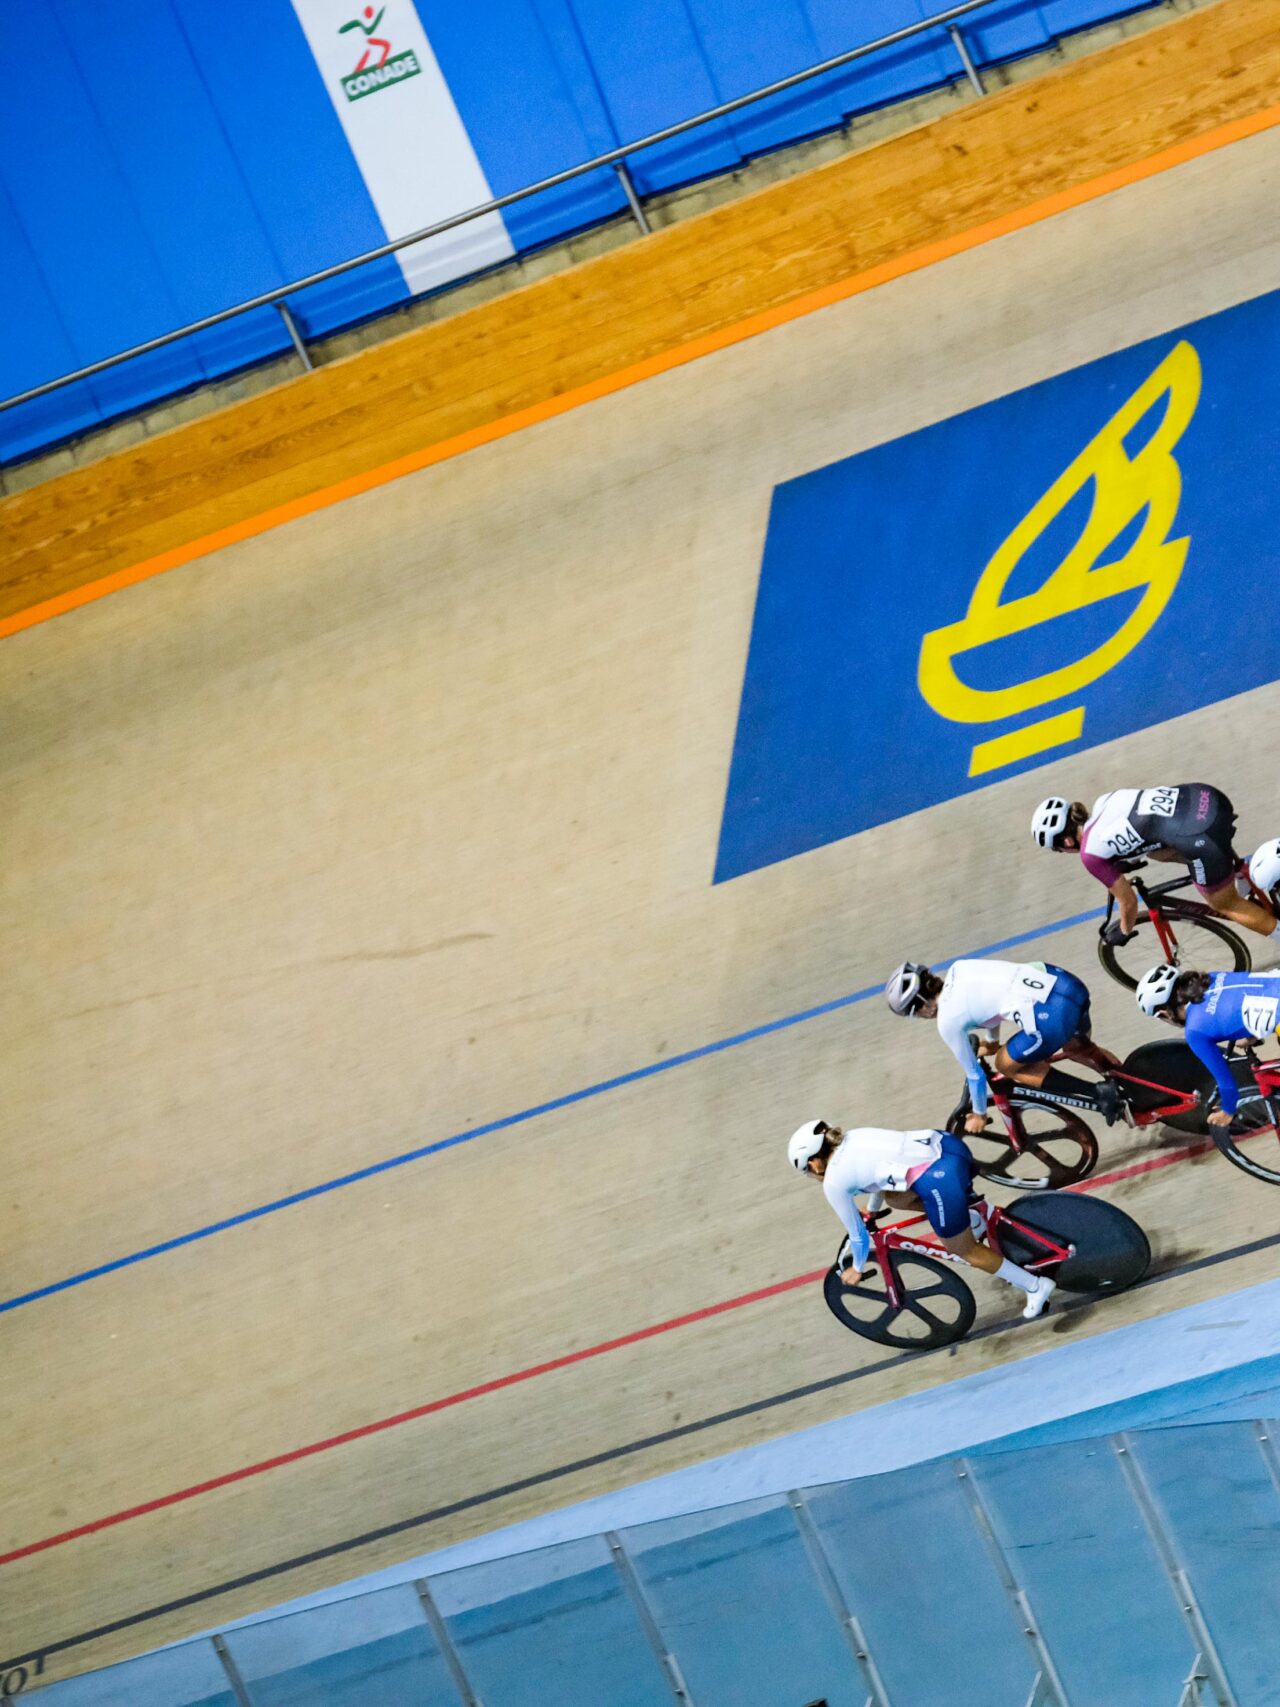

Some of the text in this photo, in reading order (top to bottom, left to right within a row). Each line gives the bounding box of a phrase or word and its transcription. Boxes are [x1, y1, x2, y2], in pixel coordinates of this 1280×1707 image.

[344, 55, 419, 97] CONADE
[1150, 788, 1175, 814] 294
[1107, 826, 1141, 854] 294
[1022, 978, 1045, 990] 6
[1243, 1007, 1275, 1032] 177
